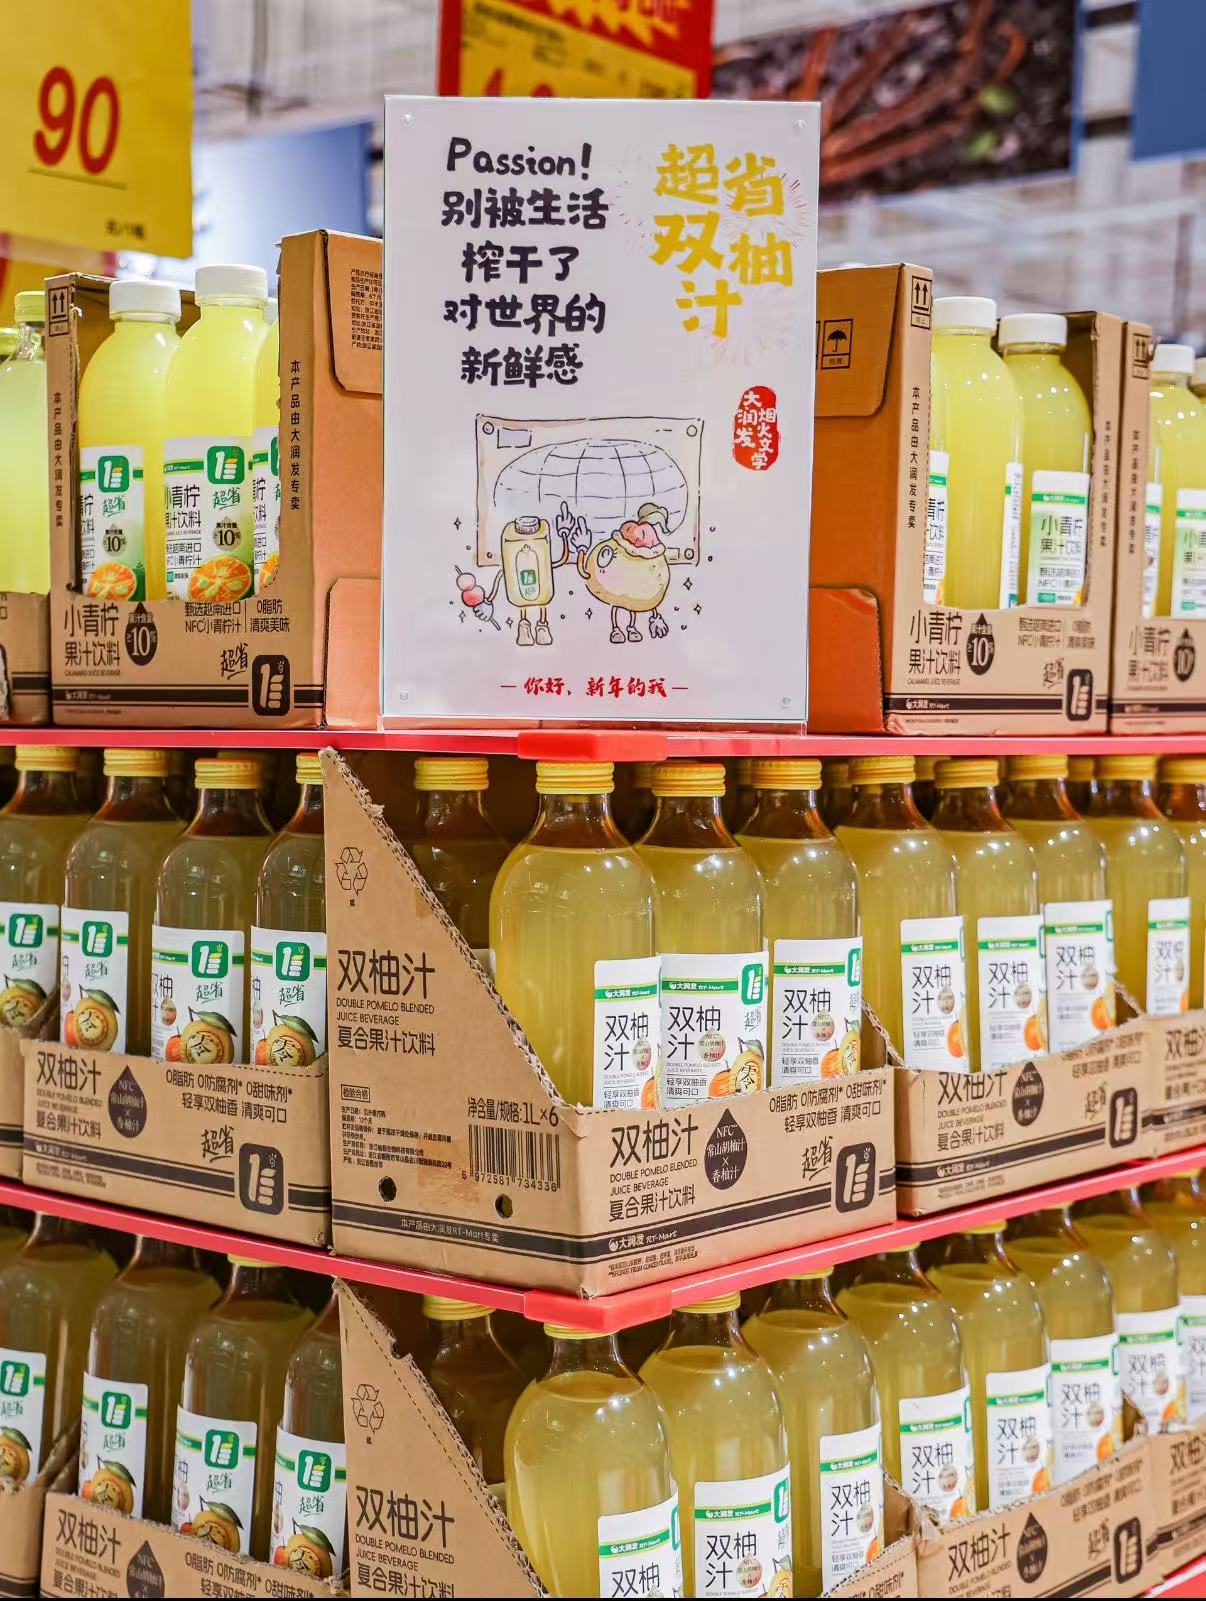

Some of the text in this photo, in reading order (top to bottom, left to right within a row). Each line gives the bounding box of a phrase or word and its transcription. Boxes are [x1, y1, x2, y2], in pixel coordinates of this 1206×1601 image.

[33, 65, 121, 176] 90
[446, 136, 592, 181] Passion!
[653, 143, 785, 218] 超省
[441, 188, 609, 229] 别被生活
[461, 241, 579, 284] 榨干了
[649, 212, 792, 287] 双柚
[443, 293, 606, 337] 对世界的
[675, 280, 742, 339] 汁
[460, 343, 583, 388] 新鲜感
[734, 390, 762, 448] 大润发
[290, 360, 300, 510] 本产品由大润发专卖
[751, 408, 776, 470] 烟火文学
[908, 385, 920, 528] 本产品由大润发专卖
[103, 495, 126, 517] 超省
[213, 486, 241, 511] 超省
[64, 603, 119, 637] 小青柠
[185, 599, 282, 616] 甄选越南进口 0脂肪
[250, 617, 290, 632] 清爽美味
[910, 610, 962, 645] 小青柠
[65, 640, 121, 667] 果汁饮料
[220, 642, 248, 680] 超省
[908, 649, 961, 675] 果汁饮料
[1056, 945, 1095, 968] 双柚
[337, 949, 436, 999] 双柚汁
[677, 982, 697, 990] 大润发
[912, 963, 951, 989] 双柚
[988, 961, 1028, 985] 双柚
[1056, 969, 1078, 991] 汁
[196, 981, 223, 1005] 超省
[279, 984, 306, 1008] 超省
[783, 988, 831, 1014] 双柚
[912, 990, 934, 1015] 汁
[988, 986, 1011, 1009] 汁
[336, 998, 435, 1015] DOUBLE POMELO BLENDED
[336, 1012, 400, 1026] JUICE BEVERAGE
[668, 1005, 720, 1032] 双柚
[604, 1011, 649, 1041] 双柚
[782, 1015, 808, 1040] 汁
[337, 1025, 436, 1057] 复合果汁饮料
[667, 1033, 694, 1060] 汁
[603, 1043, 630, 1071] 汁
[782, 1057, 818, 1065] 轻享双柚香
[782, 1066, 811, 1074] 清爽可口
[37, 1051, 102, 1095] 双柚汁
[166, 1069, 194, 1088] 0脂肪
[667, 1078, 706, 1087] 轻享双柚香
[667, 1087, 699, 1096] 清爽可口
[937, 1070, 1007, 1105] 双柚汁
[182, 1092, 287, 1123] 轻享双柚香 清爽可口
[769, 1094, 798, 1113] 0脂肪
[785, 1100, 881, 1133] 轻享双柚香 清爽可口
[938, 1108, 960, 1118] DOUBLE
[36, 1110, 101, 1140] 复合果汁饮料
[937, 1122, 1004, 1151] 复合果汁饮料
[201, 1124, 234, 1163] 超省
[610, 1113, 699, 1168] 双柚汁
[707, 1138, 746, 1158] 常山胡柚汁
[610, 1159, 697, 1183] DOUBLE POMELO BLENDED
[802, 1135, 833, 1181] 超省
[461, 1171, 557, 1193] 6 972581 734336
[610, 1177, 669, 1196] JUICE BEVERAGE
[712, 1166, 739, 1183] 香柚汁
[609, 1184, 695, 1222] 复合果汁饮料
[401, 1219, 499, 1243] 本产品由大润发RT-Mart专卖
[619, 1230, 678, 1249] 大润发 RT-Mart
[1061, 1382, 1100, 1405] 双柚
[997, 1416, 1037, 1440] 双柚
[1061, 1406, 1083, 1429] 汁
[912, 1441, 953, 1470] 双柚
[997, 1442, 1018, 1465] 汁
[207, 1471, 233, 1494] 超省
[831, 1480, 871, 1510] 双柚
[912, 1470, 935, 1494] 汁
[299, 1494, 325, 1517] 超省
[356, 1485, 455, 1548] 双柚汁
[831, 1510, 853, 1536] 汁
[56, 1509, 121, 1565] 双柚汁
[355, 1534, 455, 1564] DOUBLE POMELO BLENDED
[619, 1542, 639, 1552] 大润发
[705, 1531, 757, 1560] 双柚
[185, 1552, 214, 1576] 0脂肪
[356, 1548, 419, 1571] JUICE BEVERAGE
[948, 1522, 1011, 1582] 双柚汁
[357, 1561, 455, 1598] 复合果汁饮料
[612, 1562, 660, 1598] 双柚
[705, 1561, 733, 1589] 汁
